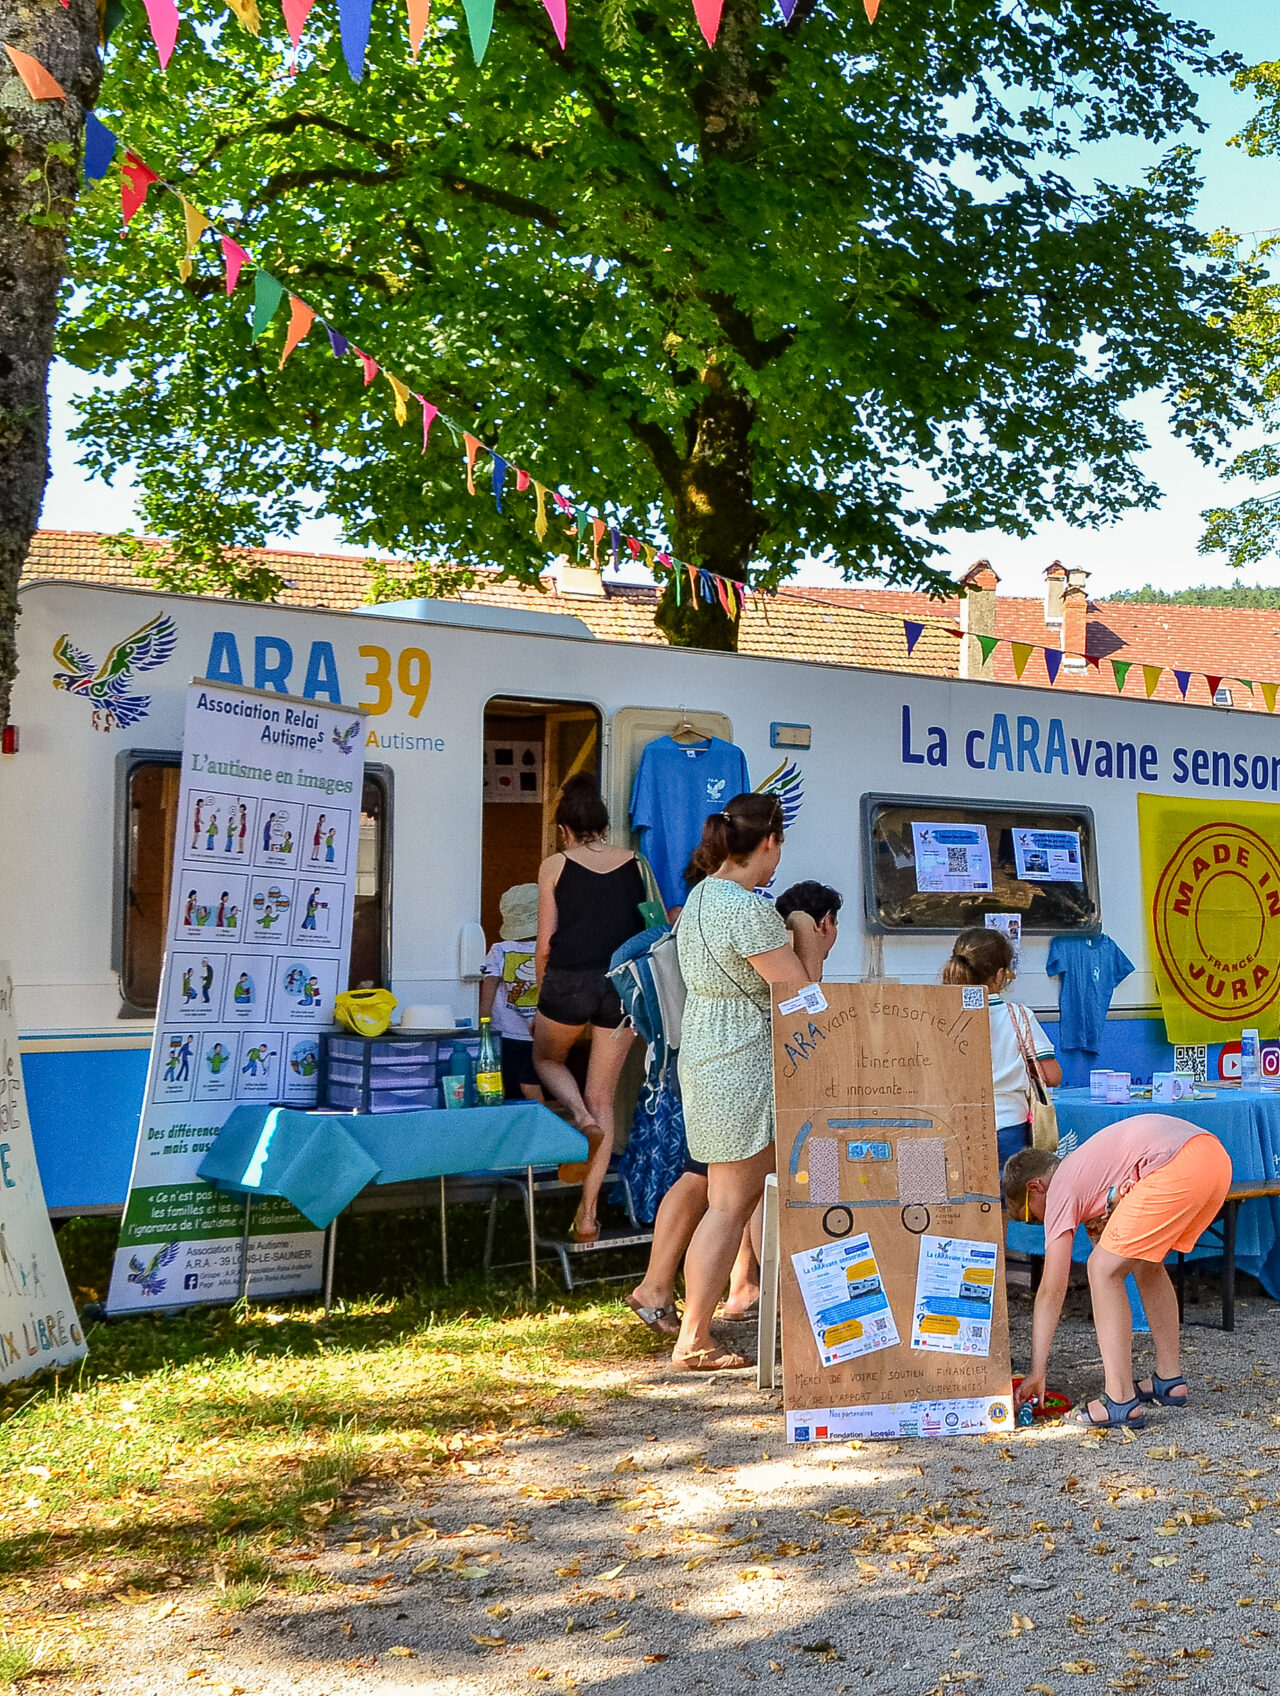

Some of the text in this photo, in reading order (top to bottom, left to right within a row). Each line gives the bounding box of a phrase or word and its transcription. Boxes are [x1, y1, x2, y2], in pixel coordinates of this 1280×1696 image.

[205, 632, 431, 718] ARA 39
[197, 693, 319, 730] Association Relai
[365, 731, 445, 752] Autisme
[902, 705, 948, 767] La
[965, 713, 1158, 781] cARAvane
[191, 754, 353, 796] L'autisme en images
[1172, 844, 1250, 917] MADE
[1207, 953, 1255, 973] FRANCE
[1188, 962, 1270, 1001] JURA
[870, 1001, 969, 1055] sensorielle
[857, 1042, 933, 1069] itinérante
[824, 1079, 838, 1098] et
[148, 1126, 165, 1141] Des
[163, 1141, 188, 1155] mais
[156, 1192, 168, 1203] Ce
[170, 1190, 194, 1202] n'est
[196, 1191, 212, 1203] pas
[151, 1207, 165, 1218] les
[167, 1203, 204, 1217] familles
[218, 1202, 231, 1213] les
[128, 1221, 178, 1238] l'ignorance
[180, 1218, 193, 1230] de
[194, 1215, 237, 1230] l'autisme
[186, 1244, 232, 1256] Association
[256, 1240, 289, 1251] Autisme
[220, 1257, 230, 1266] 39
[795, 1365, 987, 1389] MERCI DE VOTRE SOUTIEN FINANCIER
[813, 1396, 824, 1405] DE
[881, 1391, 893, 1400] DE
[904, 1388, 920, 1397] VOS
[841, 1409, 873, 1418] partenaires
[829, 1431, 864, 1440] Fondation
[870, 1428, 896, 1437] koesio
